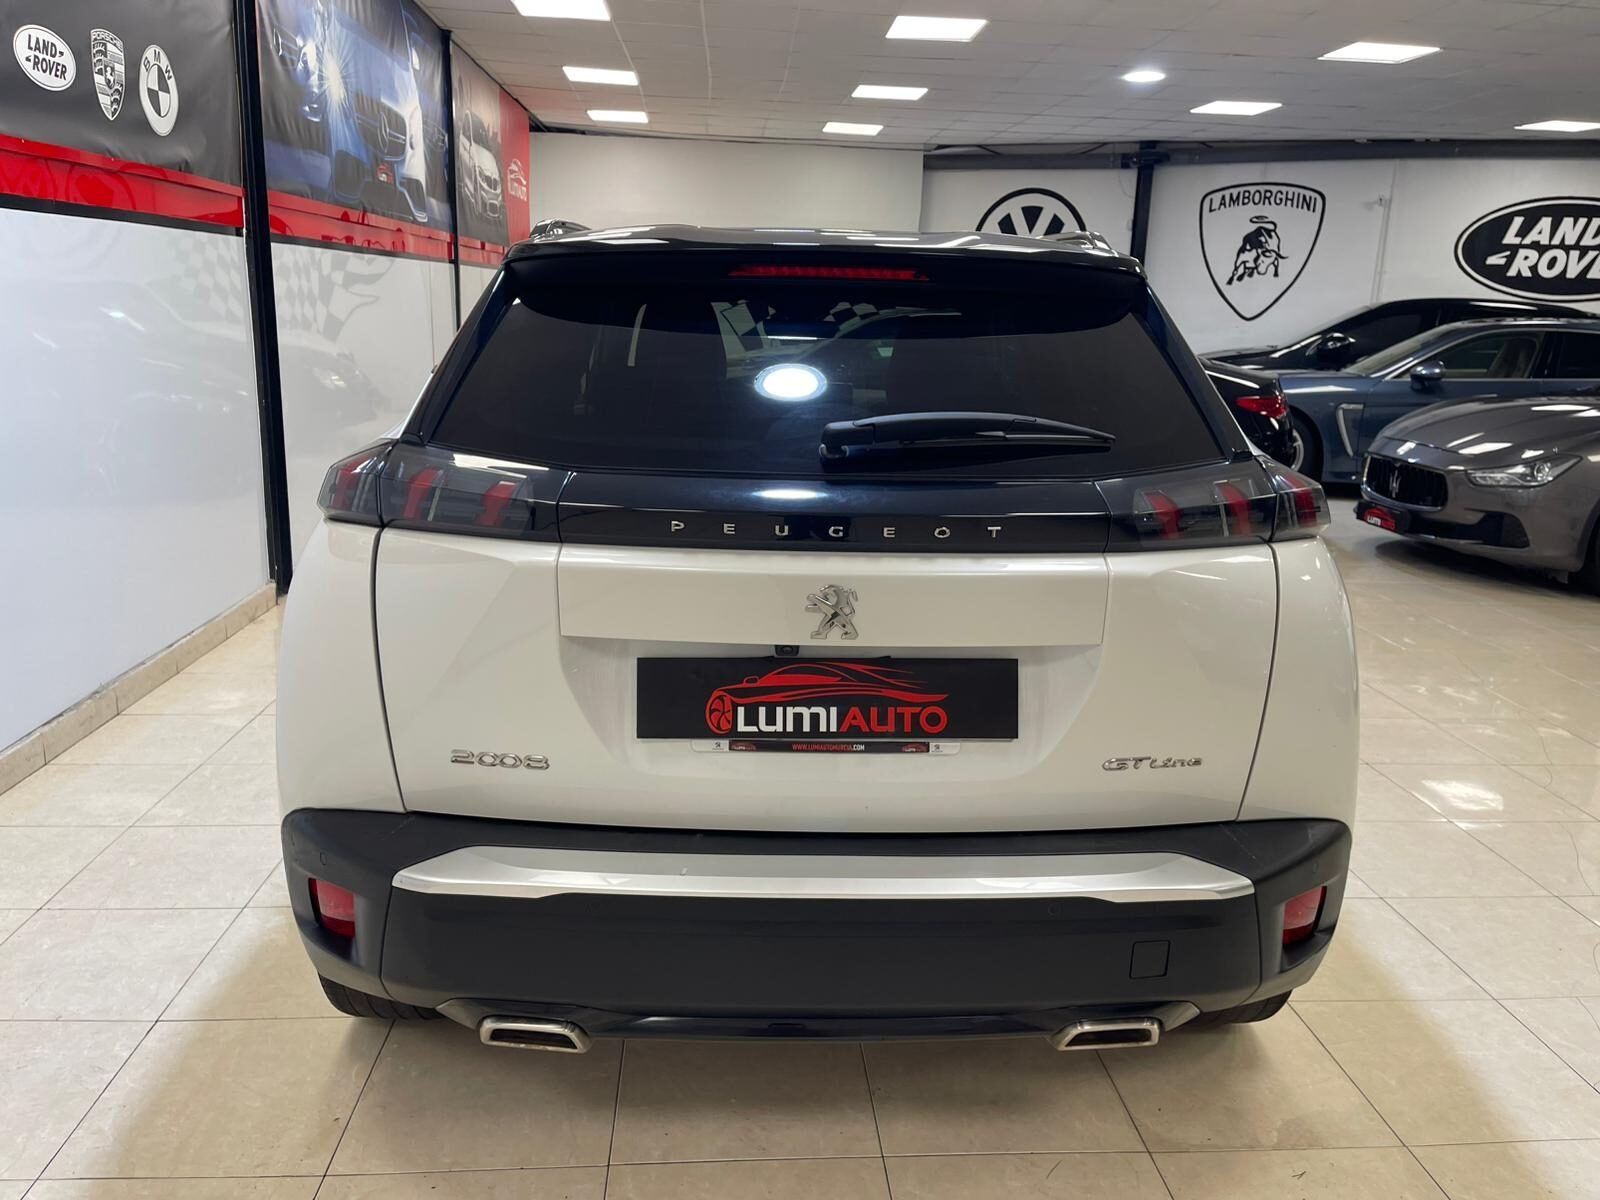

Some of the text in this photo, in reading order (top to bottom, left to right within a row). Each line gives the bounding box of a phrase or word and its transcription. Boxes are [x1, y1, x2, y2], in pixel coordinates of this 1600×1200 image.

[27, 33, 58, 59] LAND
[32, 54, 68, 81] ROVER
[143, 49, 172, 81] BMW
[1208, 189, 1318, 214] LAMBORGHINI
[670, 520, 1002, 540] PEUGEOT
[450, 748, 551, 771] 2008
